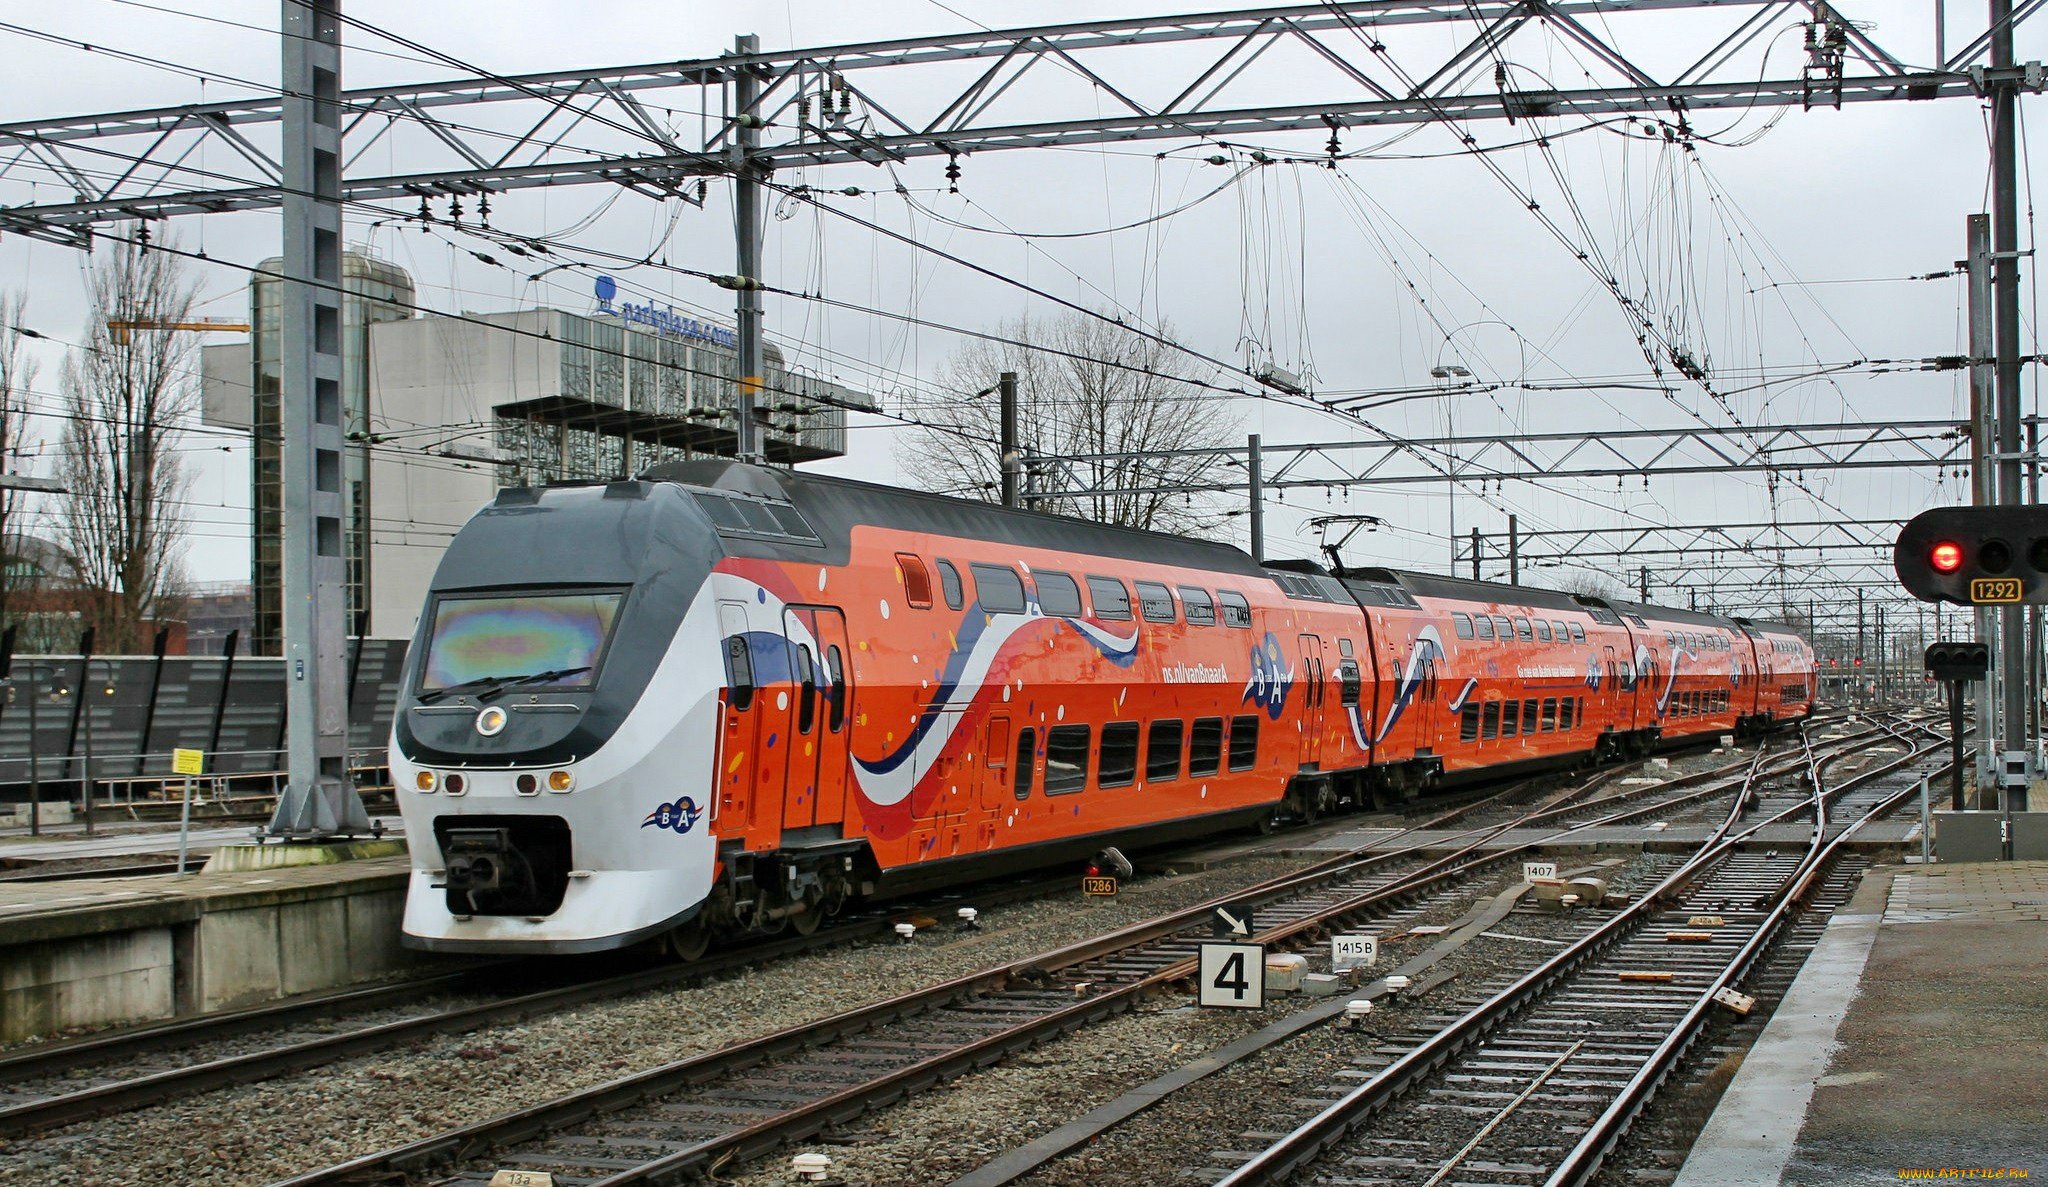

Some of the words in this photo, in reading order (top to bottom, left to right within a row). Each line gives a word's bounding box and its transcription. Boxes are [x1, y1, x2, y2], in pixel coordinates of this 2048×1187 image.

[1978, 582, 2015, 598] 1292
[661, 812, 670, 825] B
[677, 810, 690, 828] A
[1528, 867, 1552, 876] 1407
[1088, 880, 1111, 892] 1286
[1213, 952, 1249, 1000] 4
[509, 1173, 531, 1185] 13a
